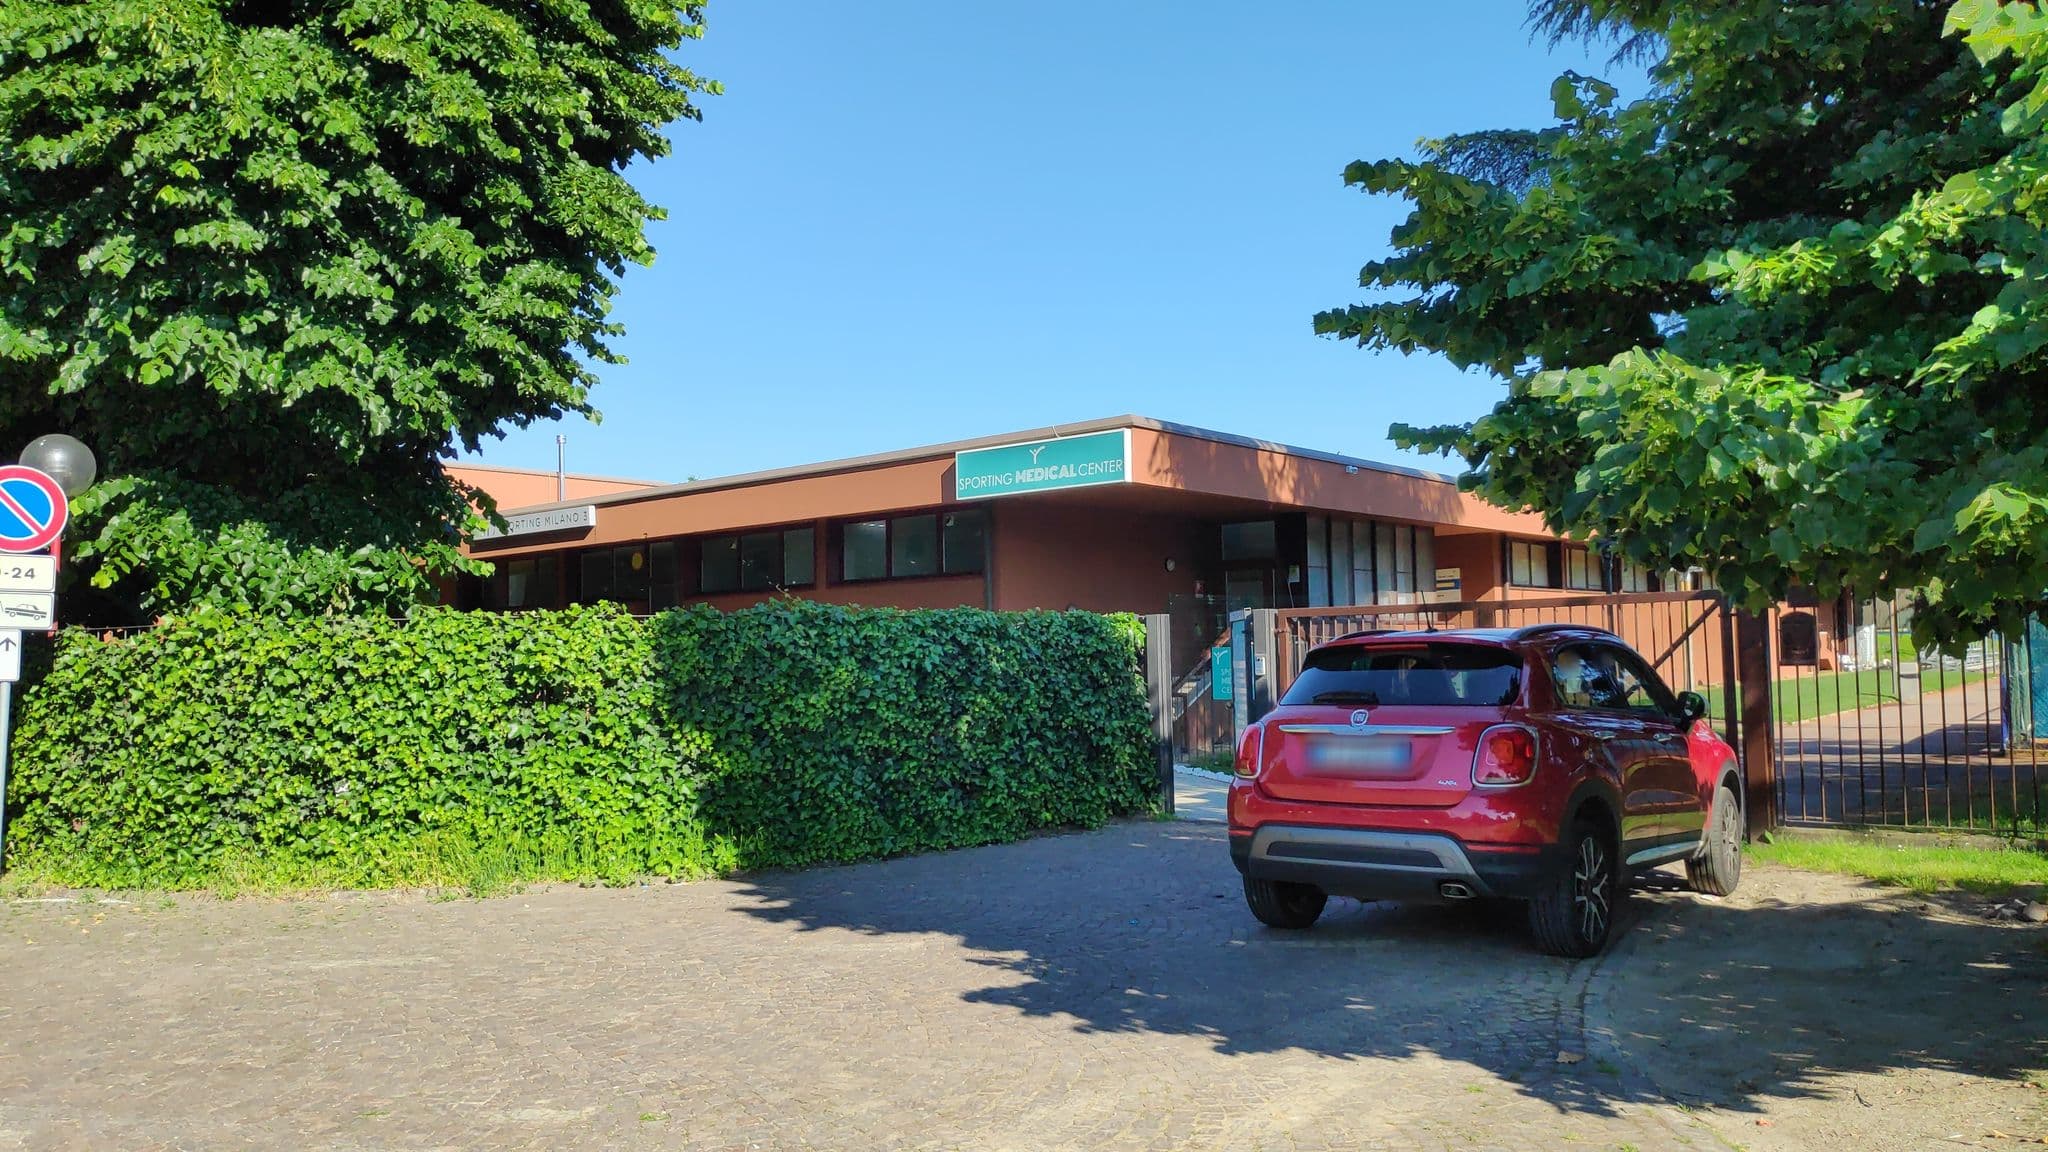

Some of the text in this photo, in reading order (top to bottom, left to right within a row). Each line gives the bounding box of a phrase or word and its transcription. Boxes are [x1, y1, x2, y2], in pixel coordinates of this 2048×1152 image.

[959, 459, 1123, 491] SPORTING MEDICAL CENTER
[544, 512, 579, 527] MILANO
[583, 511, 588, 521] 3
[0, 567, 35, 579] -24
